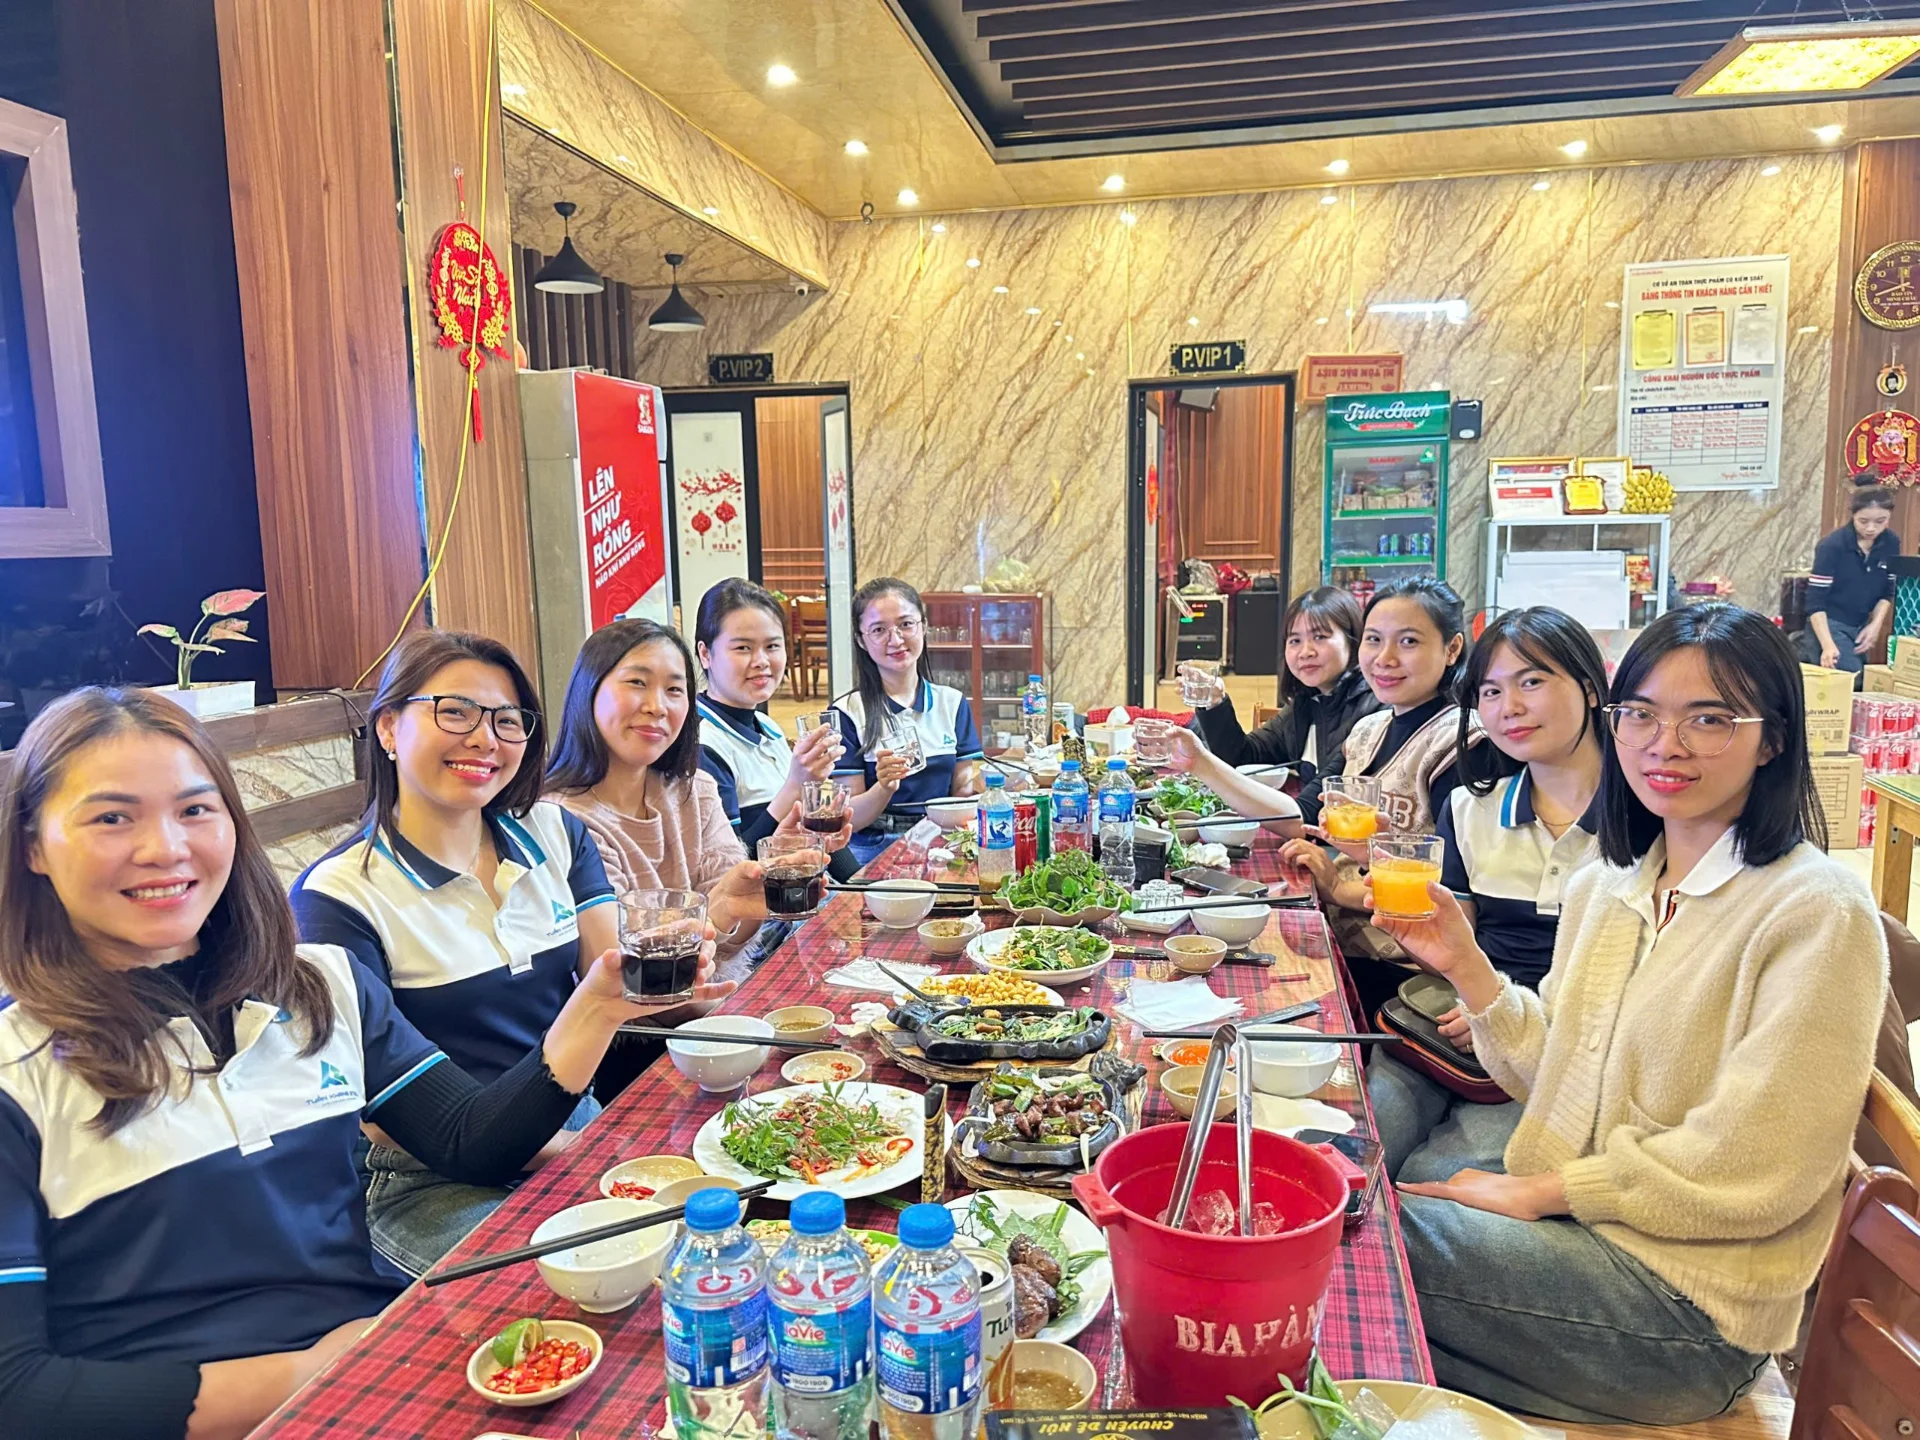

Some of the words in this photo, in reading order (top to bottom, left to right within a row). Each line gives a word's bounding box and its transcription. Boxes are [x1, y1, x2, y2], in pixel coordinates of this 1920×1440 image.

[1886, 260, 1895, 268] 11
[1900, 255, 1911, 263] 12
[1876, 270, 1886, 278] 10
[1684, 289, 1694, 298] TIN
[1696, 287, 1718, 298] KHÁCH
[1870, 283, 1878, 291] 9
[1873, 297, 1880, 305] 8
[1896, 309, 1904, 317] 6
[1344, 402, 1384, 422] Trúc
[1384, 400, 1431, 421] Bạch
[588, 465, 615, 504] LÊN
[591, 490, 621, 537] NHƯ
[592, 519, 632, 568] RỒNG
[1174, 1314, 1248, 1358] BIA
[1038, 1421, 1073, 1436] NÚI
[1105, 1420, 1175, 1432] CHUYÊN
